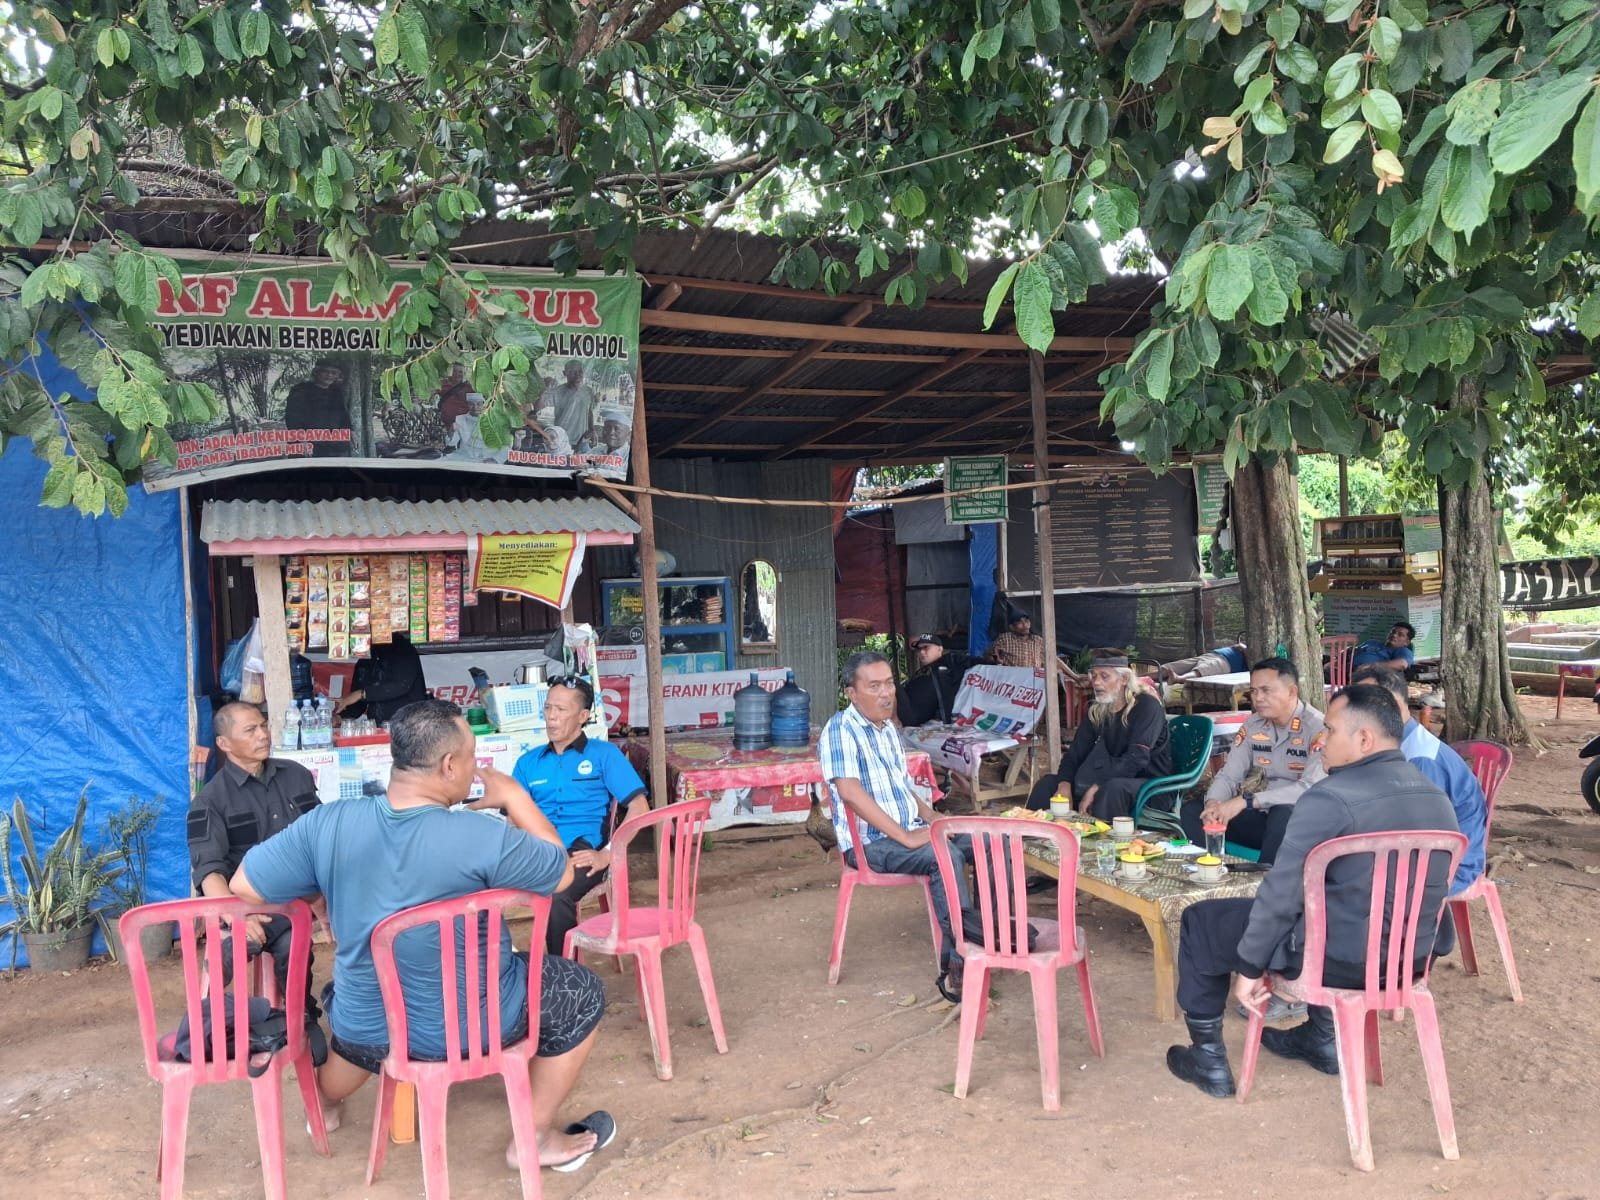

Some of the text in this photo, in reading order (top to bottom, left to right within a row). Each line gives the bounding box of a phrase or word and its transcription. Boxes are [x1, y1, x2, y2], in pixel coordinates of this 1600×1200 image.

[545, 332, 628, 359] ALKOHOL
[203, 432, 254, 452] ADALAH
[258, 428, 351, 444] KENISCAYAAN
[202, 449, 233, 467] AMAL
[236, 445, 283, 462] IBADAH
[285, 443, 305, 456] MU
[307, 442, 315, 456] ?
[508, 450, 567, 467] MUCHLIS
[498, 541, 559, 550] Menyediakan:
[662, 684, 706, 697] ERANI
[711, 682, 741, 696] KITA
